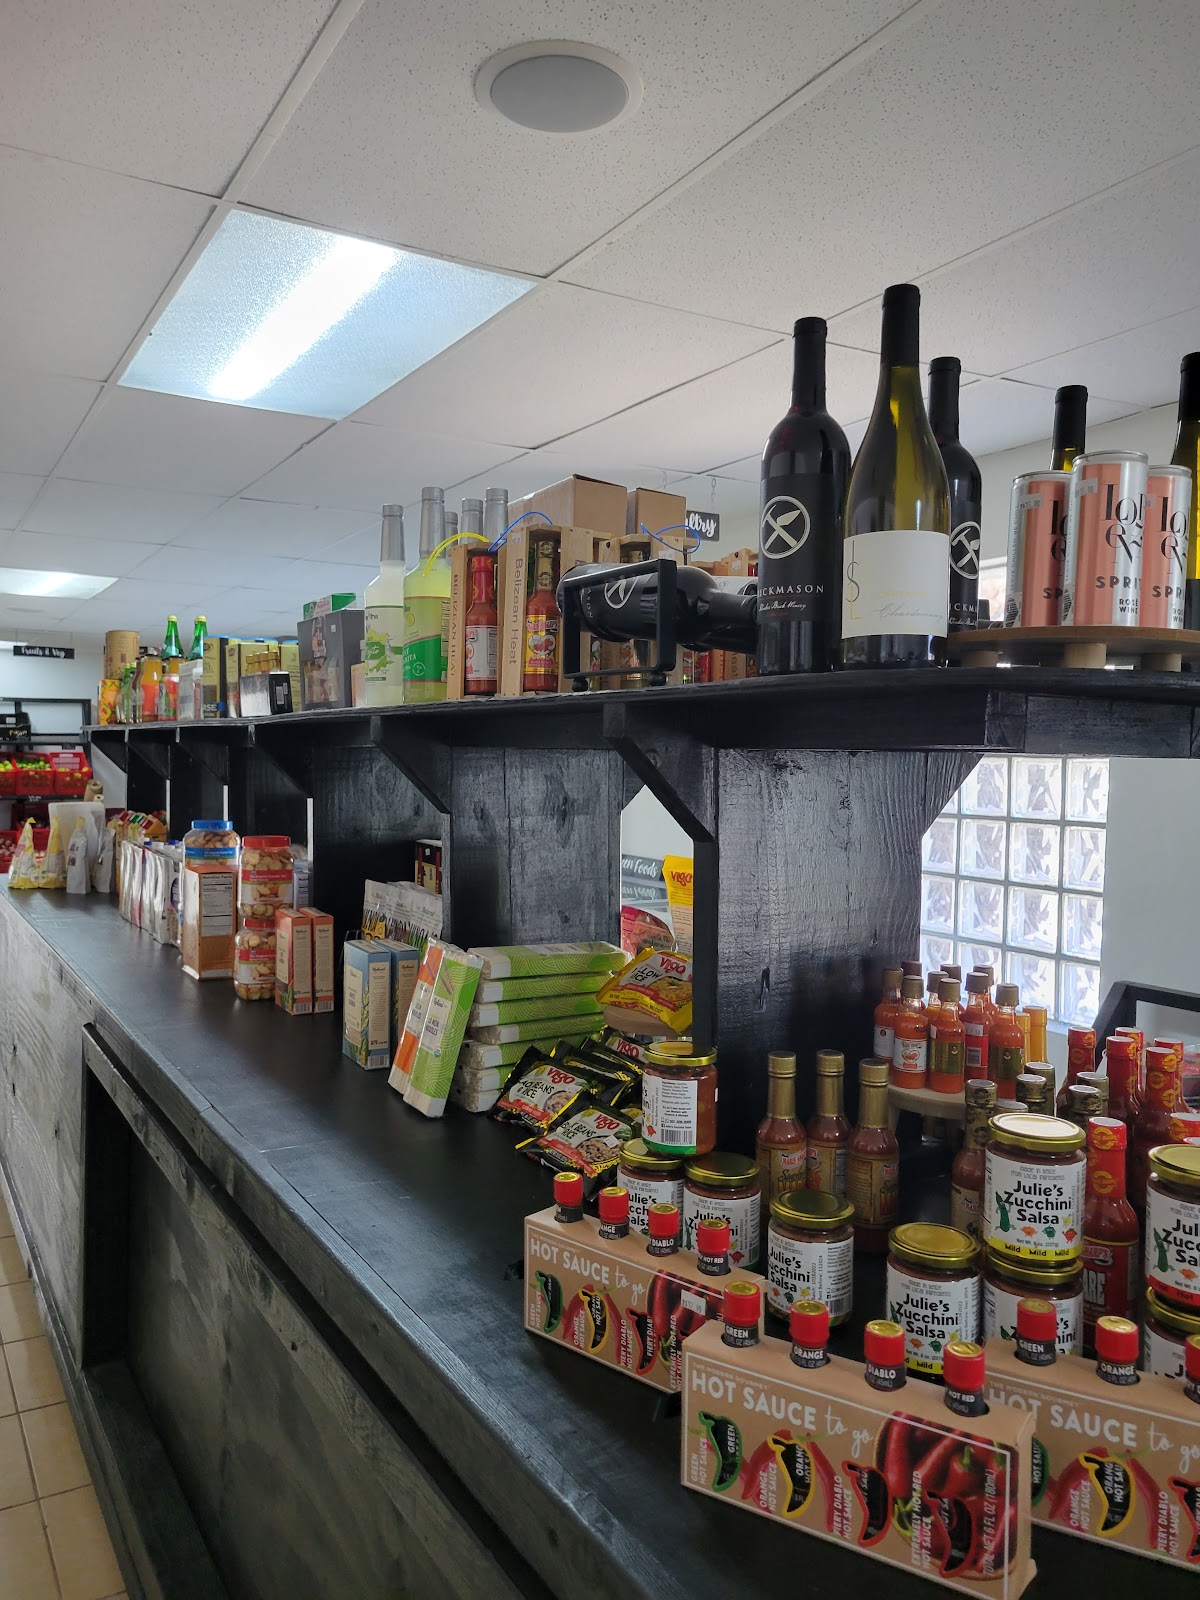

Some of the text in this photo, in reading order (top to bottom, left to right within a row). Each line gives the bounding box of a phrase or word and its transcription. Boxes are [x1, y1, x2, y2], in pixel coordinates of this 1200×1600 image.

[686, 512, 717, 537] ltry
[1096, 576, 1140, 589] SPRI
[1043, 588, 1063, 600] SP
[1152, 586, 1184, 599] SPR
[510, 558, 524, 665] Belizean Heat
[1119, 606, 1139, 615] WINE
[52, 649, 65, 659] Veg
[634, 858, 658, 878] Foods
[1014, 1180, 1064, 1197] Julie's
[628, 1192, 657, 1205] ulie's
[1003, 1190, 1072, 1211] Zucchini
[630, 1216, 649, 1228] alsa
[1016, 1208, 1060, 1225] Salsa
[600, 1224, 616, 1234] ANGE
[1172, 1218, 1200, 1237] Jul
[652, 1238, 674, 1247] DIABLO
[1005, 1243, 1070, 1257] Mild Mild Mild
[1162, 1228, 1200, 1253] Zuc
[714, 1256, 724, 1264] RED
[770, 1246, 802, 1269] Julie's
[1176, 1248, 1200, 1267] Sa
[530, 1238, 646, 1306] HOT SAUCE to go
[769, 1261, 810, 1283] ucchini
[770, 1272, 798, 1293] Salsa
[903, 1293, 950, 1313] Julie's
[896, 1302, 959, 1326] Zucchini
[726, 1325, 749, 1339] GREEN
[906, 1320, 946, 1339] Salsa
[794, 1348, 824, 1360] ORANGE
[1020, 1340, 1045, 1353] GREEN
[867, 1364, 896, 1379] DIABLO
[916, 1362, 933, 1370] Mild
[1100, 1362, 1135, 1376] ORANGE
[962, 1394, 975, 1403] RED
[692, 1370, 874, 1459] HOT SAUCE to go
[728, 1424, 736, 1454] GREEN
[988, 1388, 1200, 1474] HOT SAUCE to go
[700, 1438, 708, 1467] SAUCE
[691, 1454, 699, 1482] GREEN
[1032, 1470, 1042, 1484] HOT
[760, 1470, 768, 1508] ORANGE
[768, 1462, 778, 1511] HOT SAUCE
[1114, 1486, 1124, 1503] HOT
[833, 1476, 843, 1535] FIERY DIABLO
[844, 1490, 853, 1539] HOT SAUCE
[985, 1500, 996, 1514] OZ
[1070, 1490, 1080, 1527] ORANGE
[1081, 1480, 1091, 1530] HOT SAUCE
[912, 1471, 922, 1566] EXTREMELY HOT RED
[985, 1514, 996, 1524] FL
[1158, 1491, 1169, 1552] FIERY DIABLO
[988, 1524, 996, 1534] 6
[1168, 1504, 1180, 1556] HOT SAUCE
[922, 1516, 933, 1570] HOT SAUCE
[984, 1535, 995, 1551] NET
[984, 1553, 995, 1576] TOTAL
